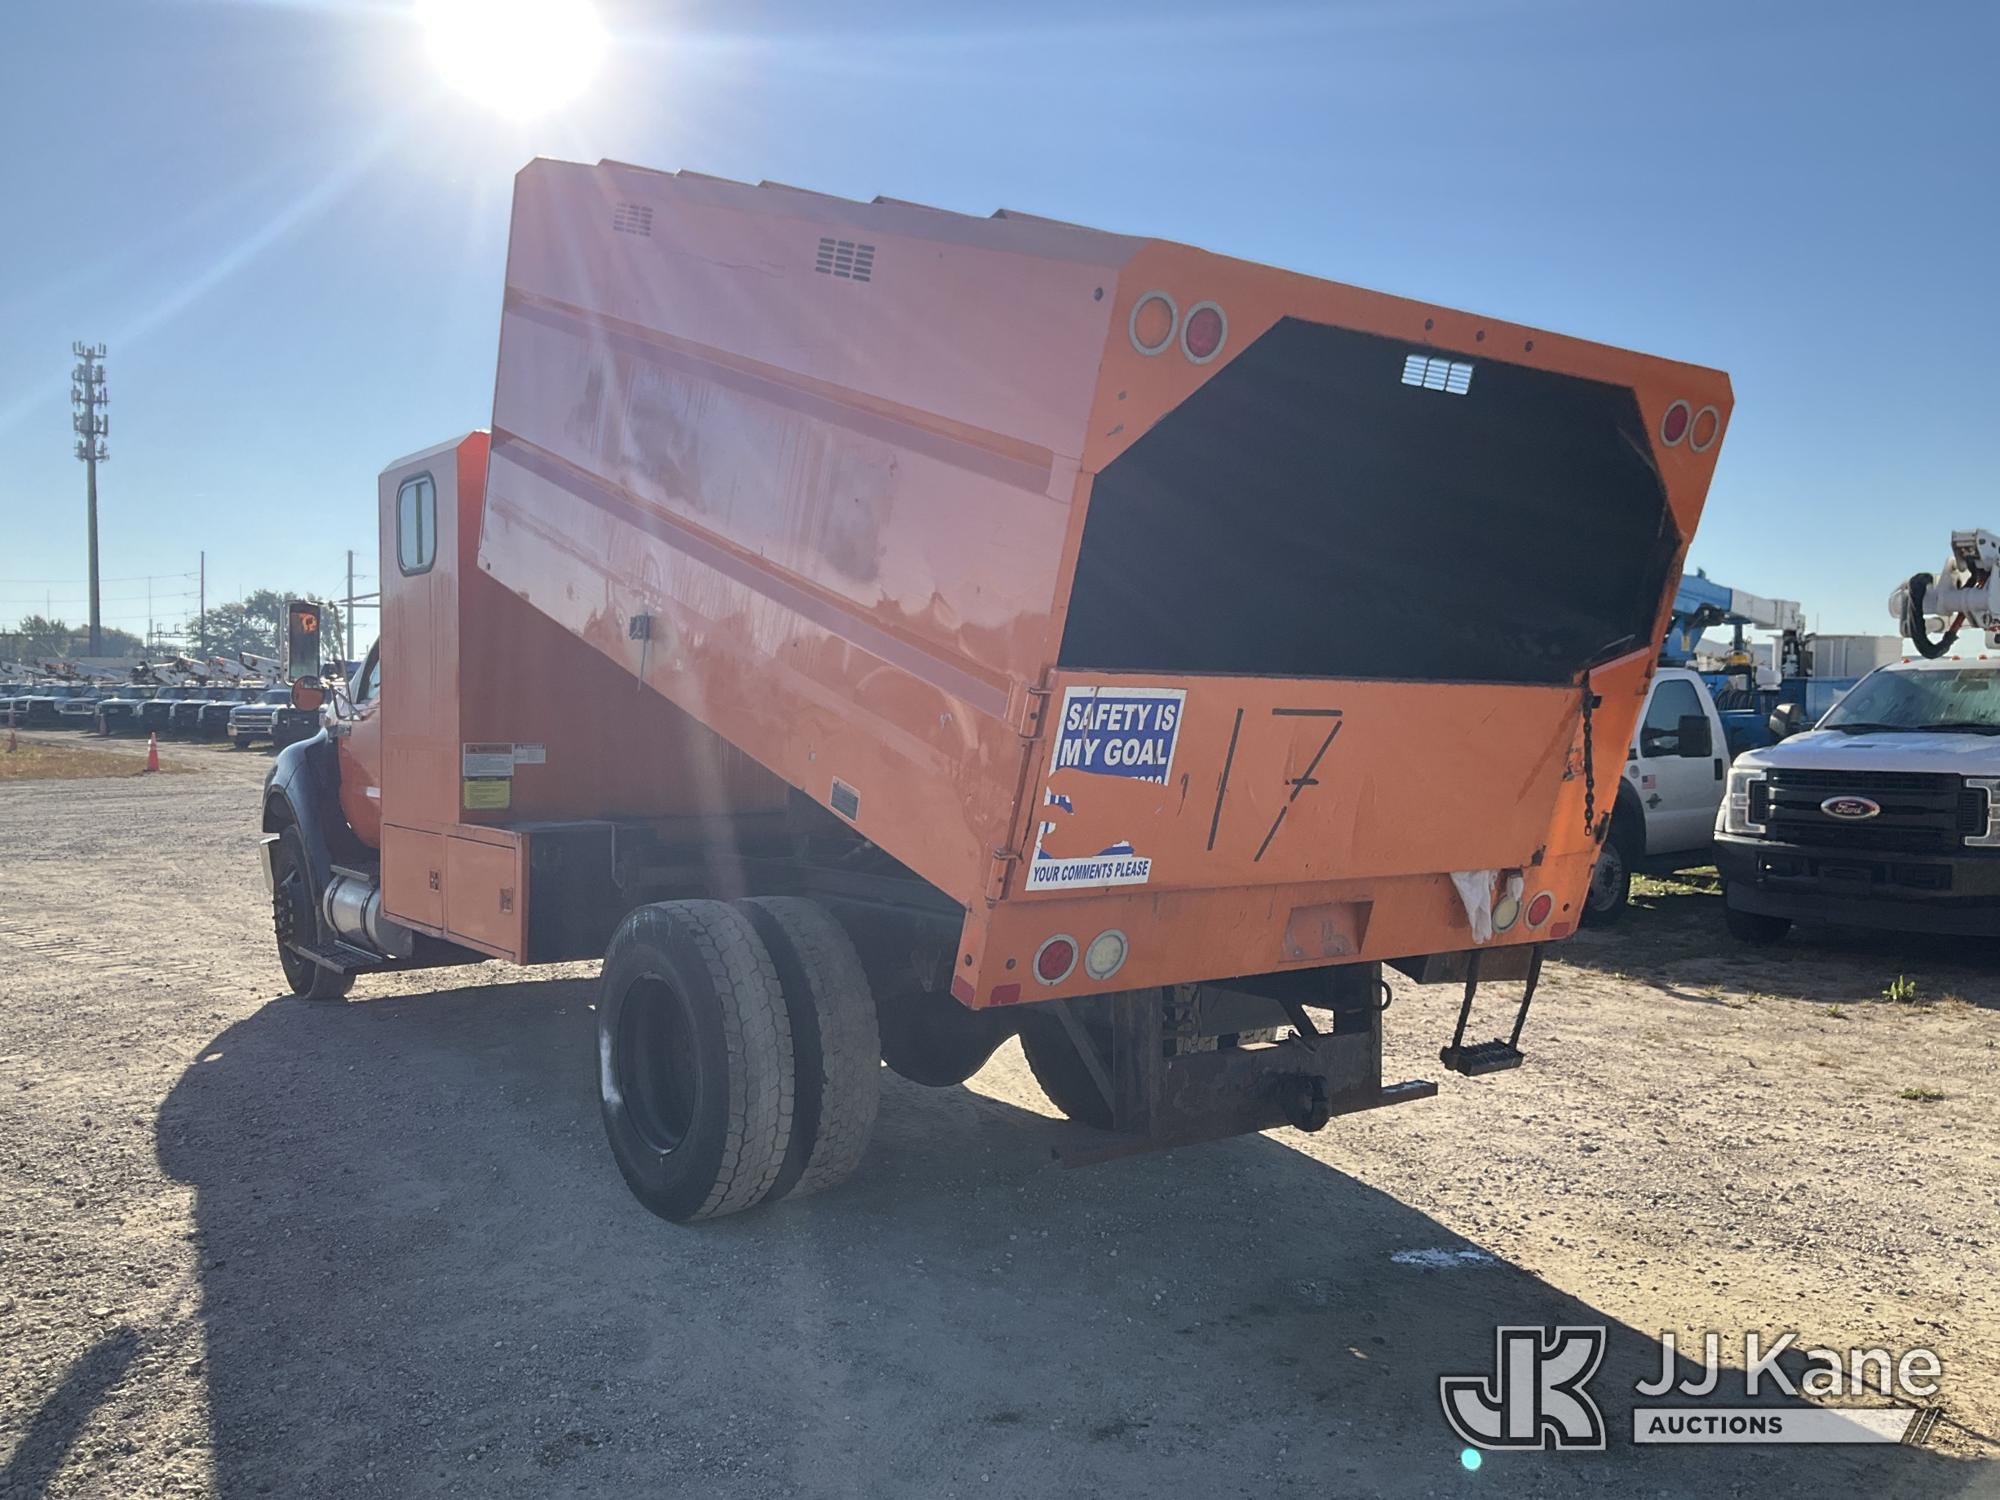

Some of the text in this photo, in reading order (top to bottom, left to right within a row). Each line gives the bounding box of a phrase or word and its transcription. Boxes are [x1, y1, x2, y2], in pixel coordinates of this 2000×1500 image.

[1066, 703, 1176, 731] SAFETY IS
[1060, 738, 1167, 766] MY GOAL
[1033, 860, 1149, 882] YOUR COMMENTS PLEASE
